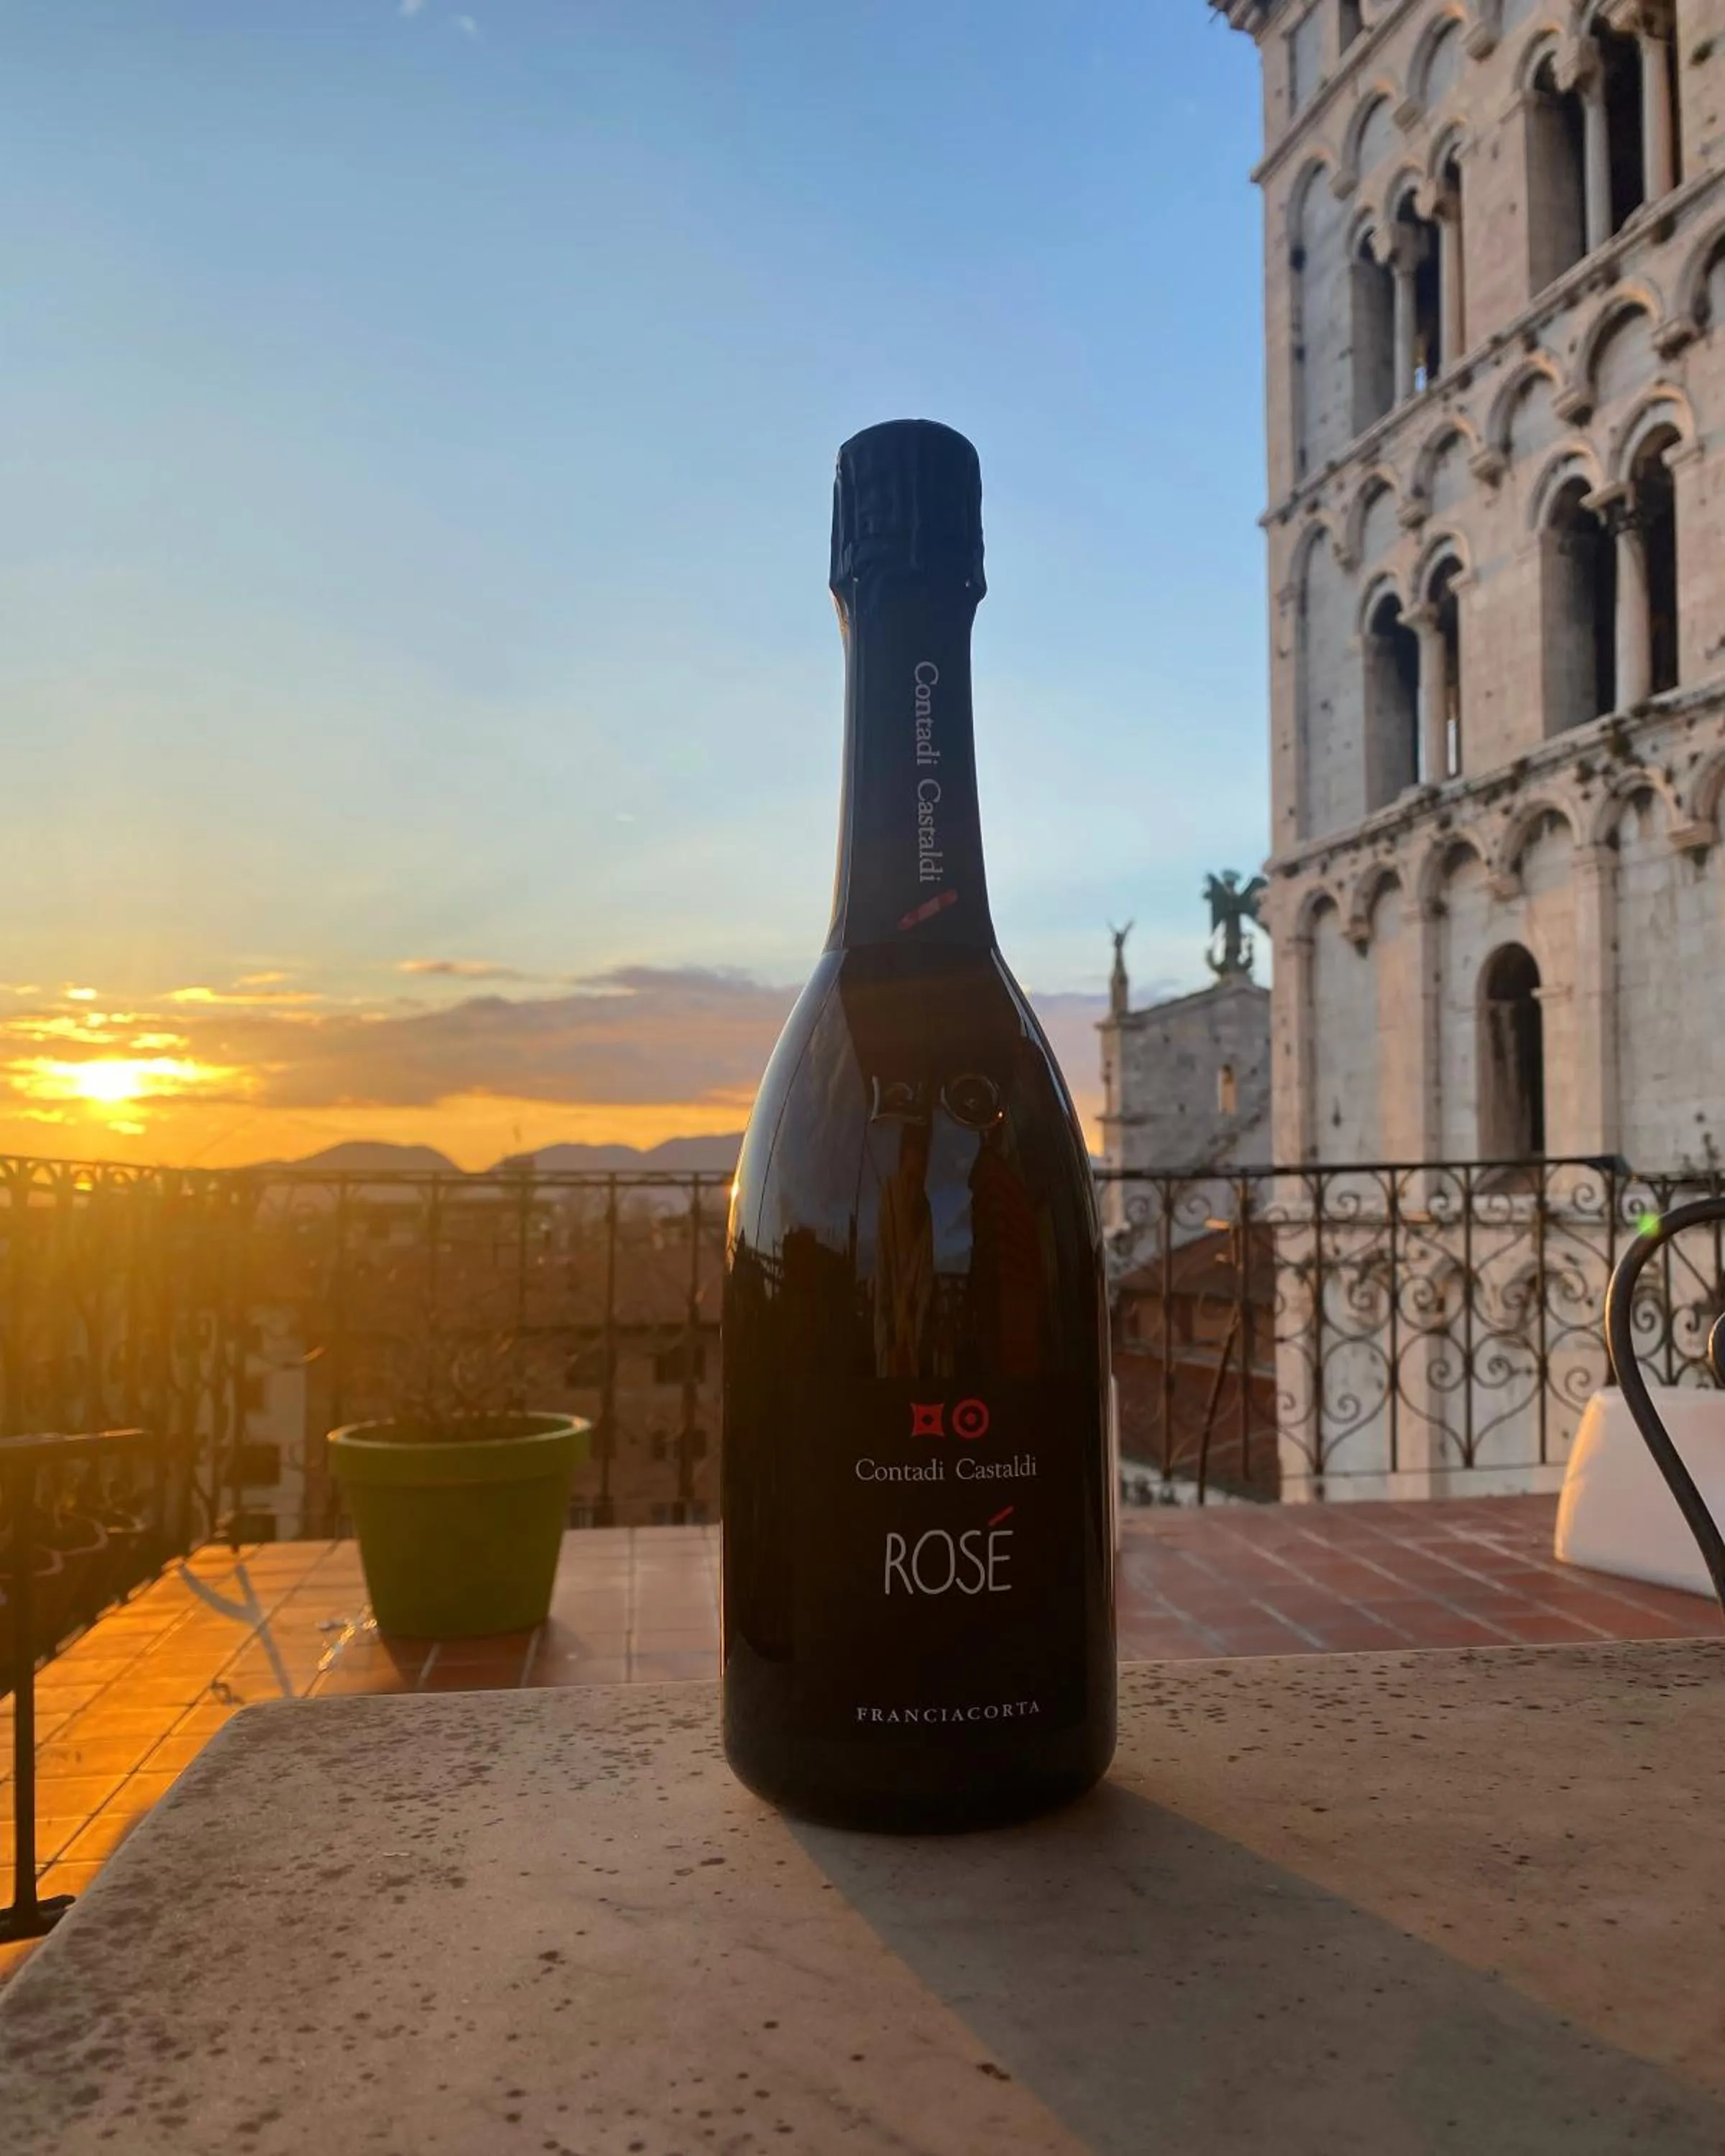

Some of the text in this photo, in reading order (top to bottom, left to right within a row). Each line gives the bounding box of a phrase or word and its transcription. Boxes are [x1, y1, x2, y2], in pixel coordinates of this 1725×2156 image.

[914, 660, 944, 883] Contadi Castaldi
[855, 1454, 1037, 1481] Contadi Castaldi
[885, 1506, 1014, 1595] ROSÉ
[857, 1700, 1040, 1723] FRANCIACORTA
